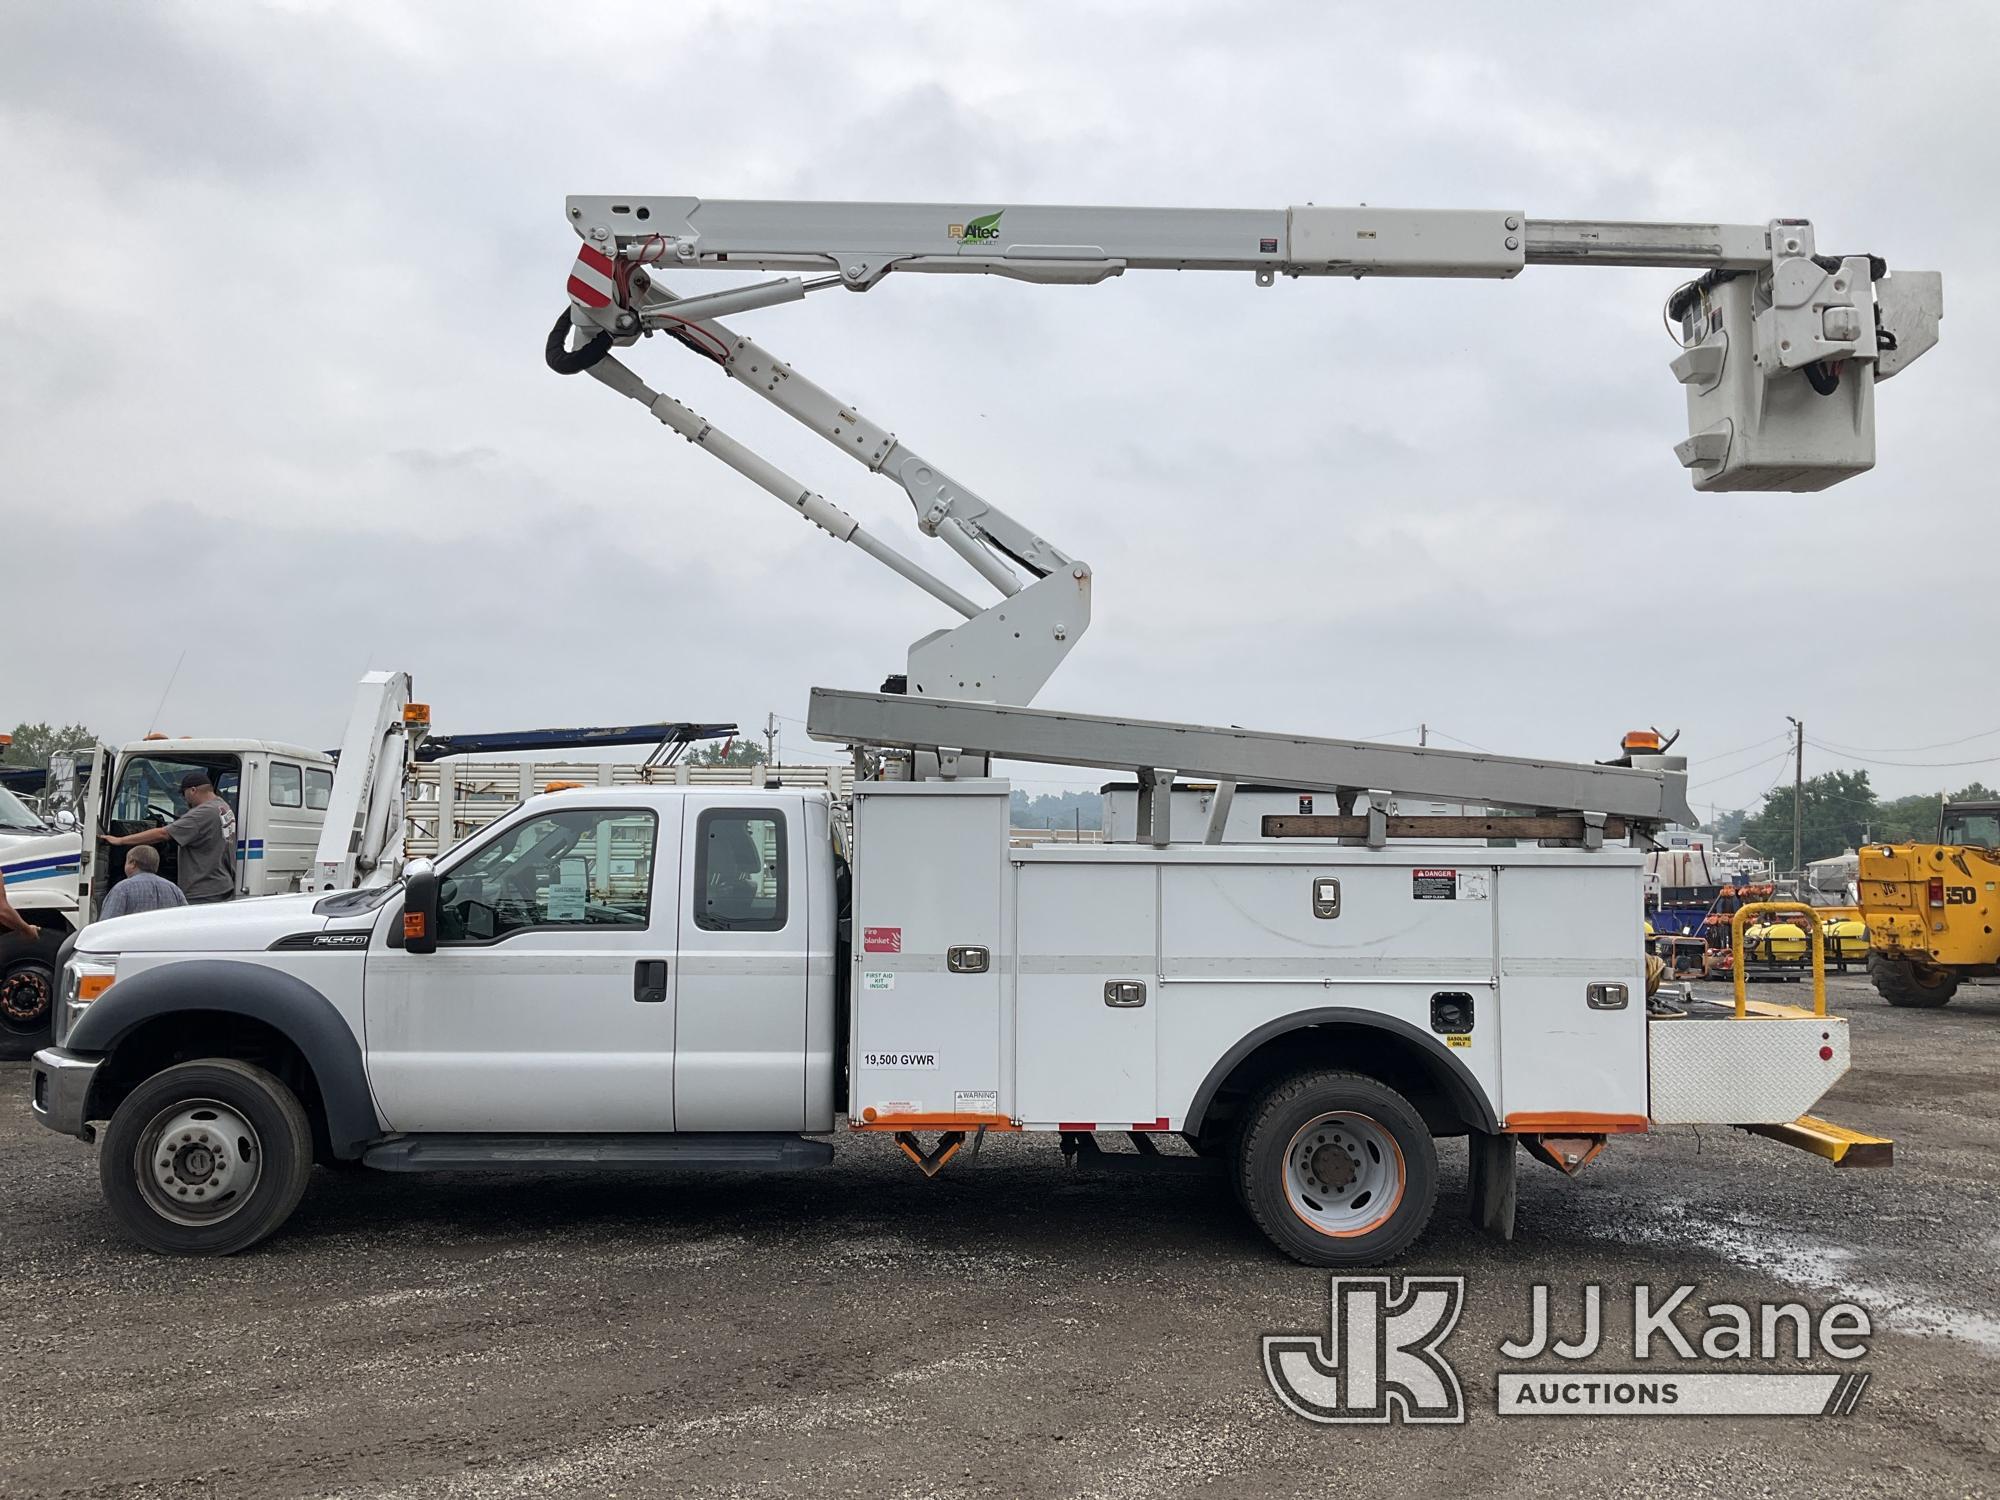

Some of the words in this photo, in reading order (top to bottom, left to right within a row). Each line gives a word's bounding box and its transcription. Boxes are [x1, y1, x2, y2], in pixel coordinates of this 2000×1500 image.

[964, 225, 1000, 239] Altec
[864, 936, 890, 945] blanket
[864, 1054, 898, 1067] 19,500
[900, 1054, 935, 1066] GVWR
[962, 1091, 995, 1099] WARNING
